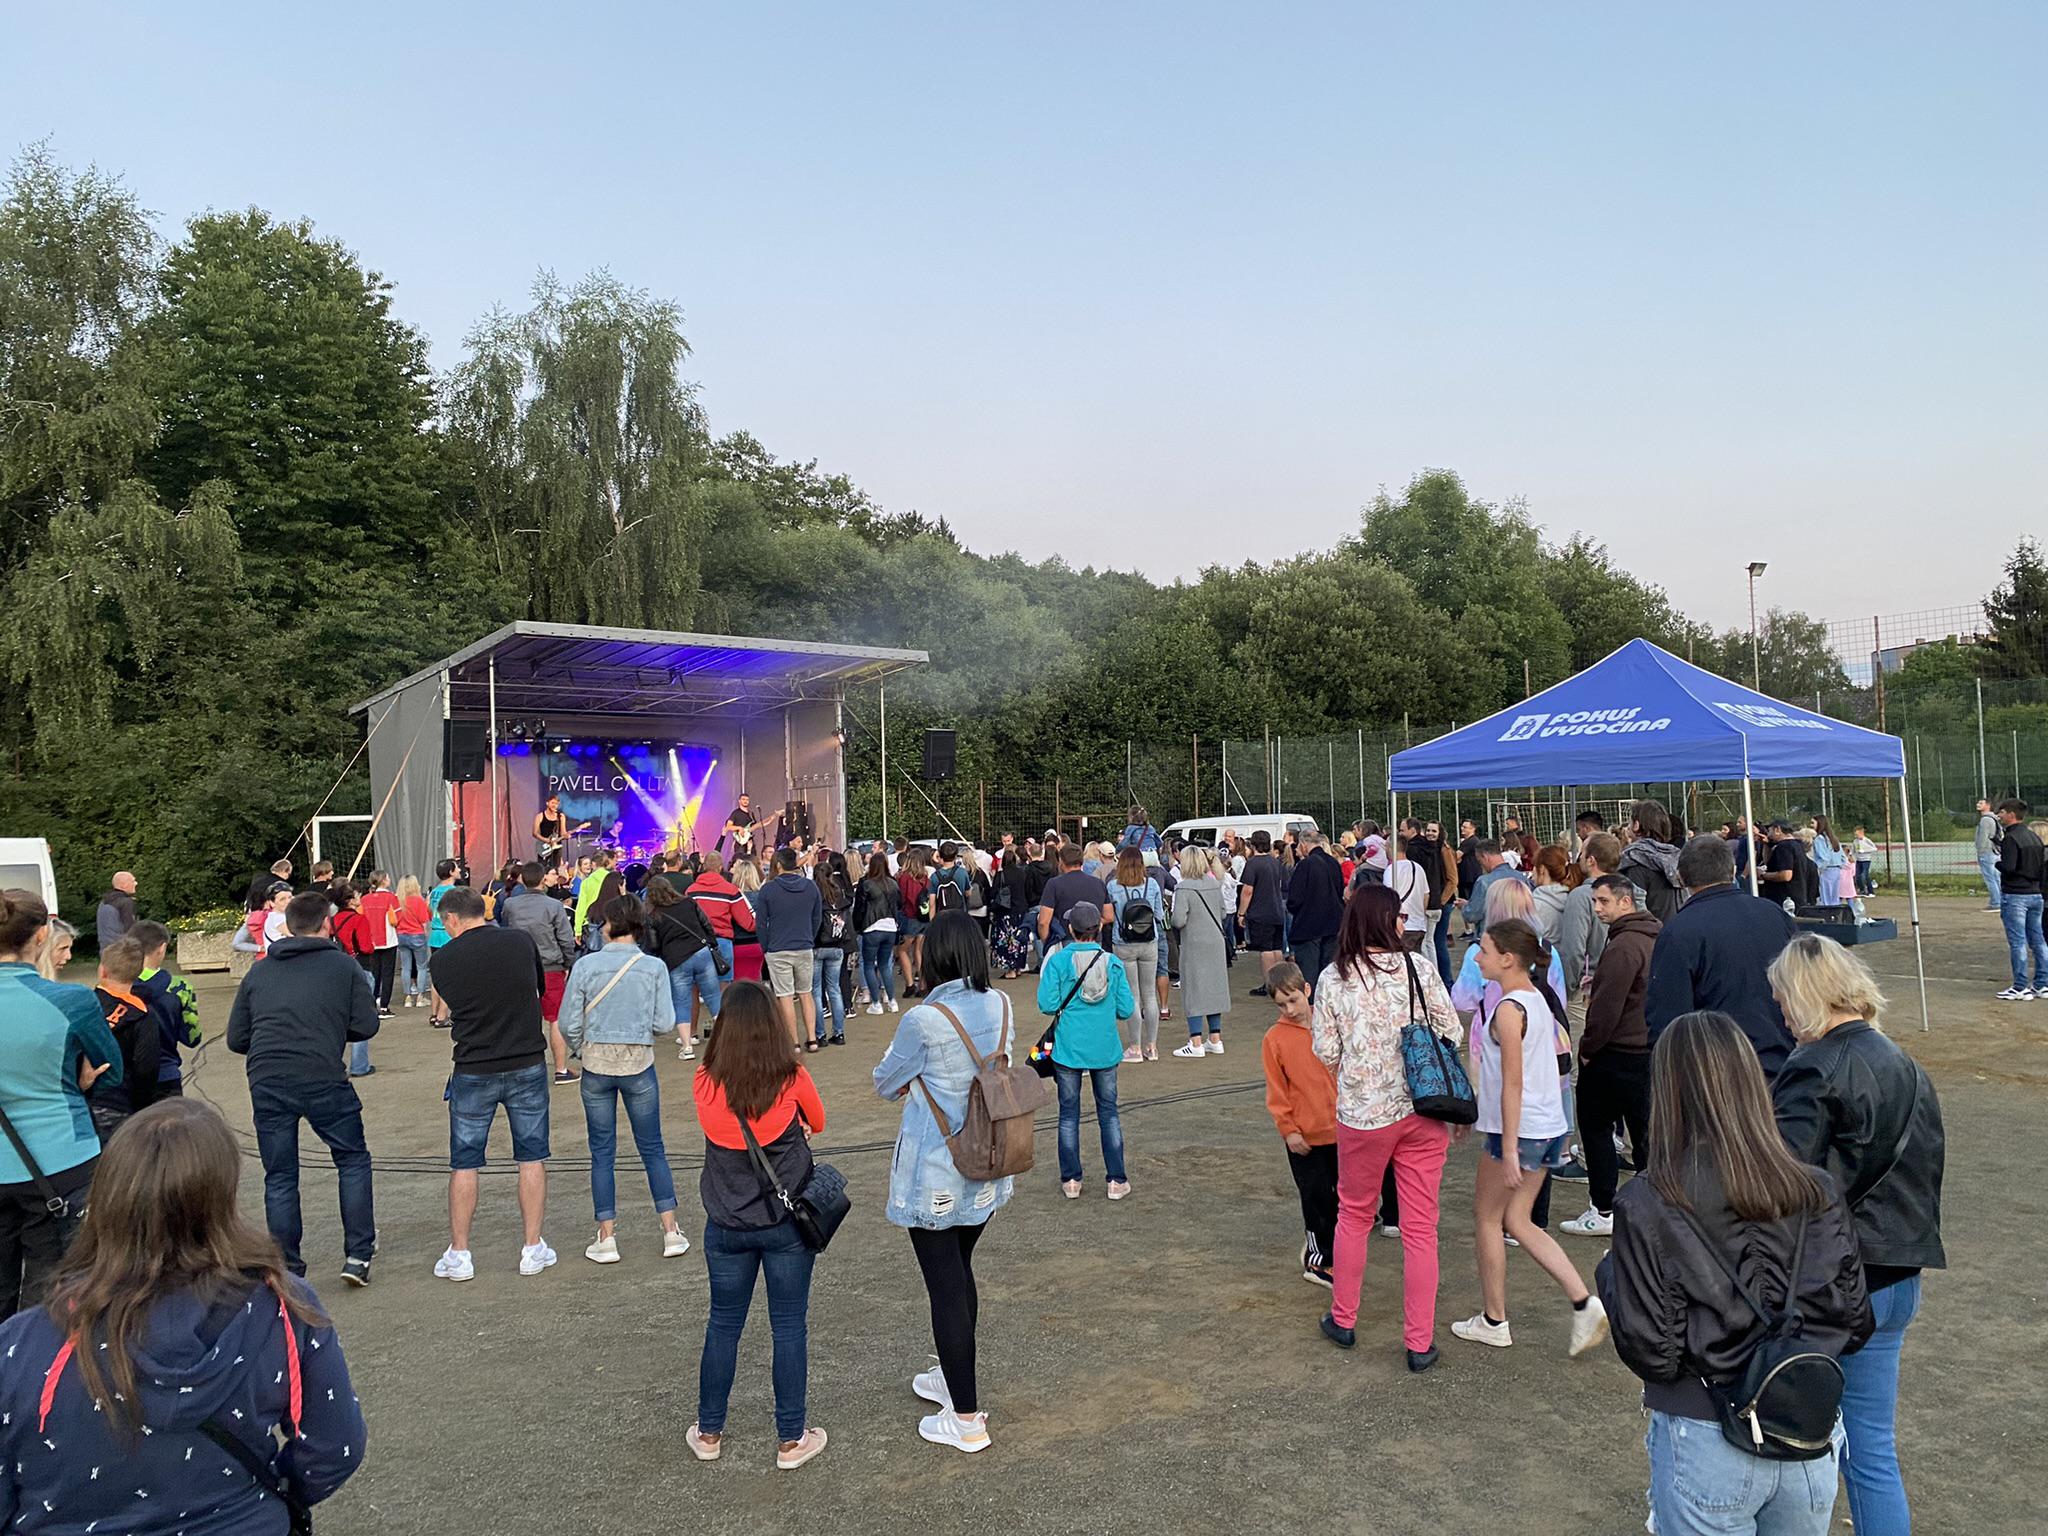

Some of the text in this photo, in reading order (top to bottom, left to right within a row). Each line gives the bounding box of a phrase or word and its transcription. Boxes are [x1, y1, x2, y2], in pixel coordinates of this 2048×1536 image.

[1550, 707, 1642, 726] FOKUS
[1540, 718, 1672, 738] VYSOČINA
[549, 775, 604, 792] PAVEL
